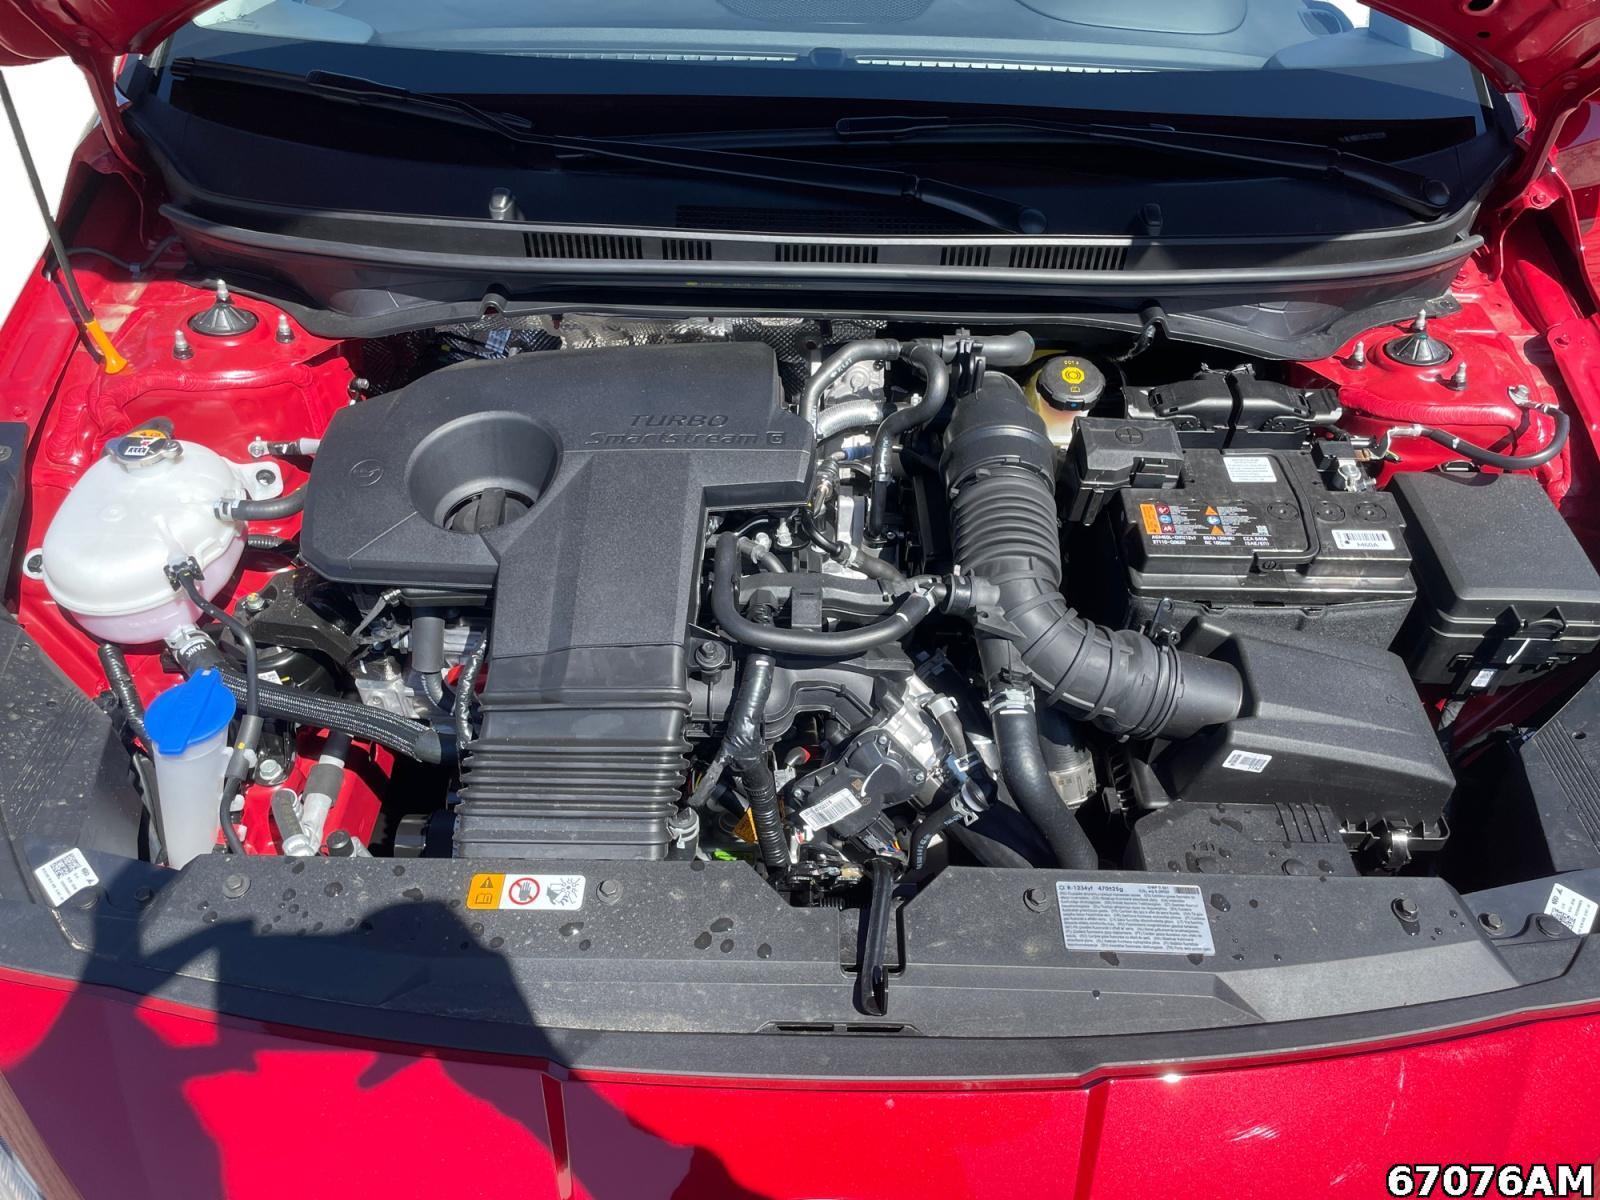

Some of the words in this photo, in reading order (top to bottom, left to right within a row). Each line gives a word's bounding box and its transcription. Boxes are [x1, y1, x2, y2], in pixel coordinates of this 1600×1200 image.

[630, 413, 729, 428] TURBO
[584, 430, 760, 446] Smartstream
[185, 642, 208, 658] TANK
